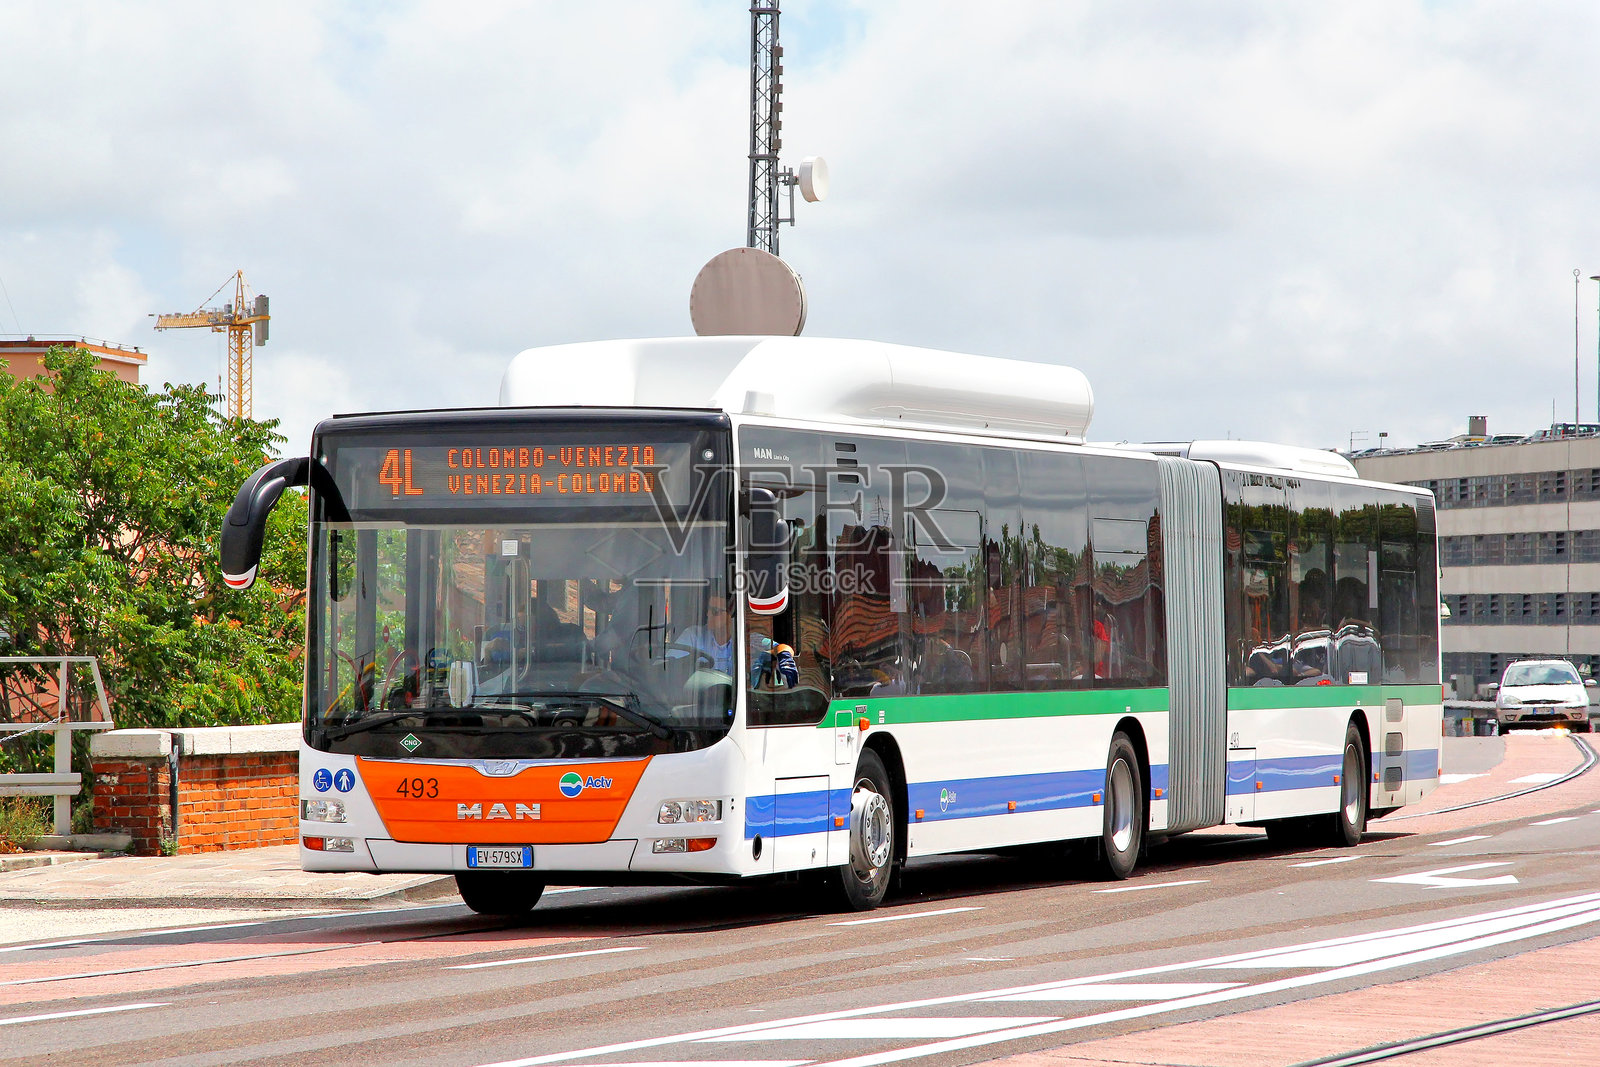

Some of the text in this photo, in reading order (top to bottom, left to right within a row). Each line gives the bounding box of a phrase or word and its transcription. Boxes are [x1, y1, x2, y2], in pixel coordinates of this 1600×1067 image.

[447, 446, 655, 469] COLOMBO-VENEZIA
[753, 447, 773, 460] MAN
[379, 449, 423, 495] 4L
[447, 472, 655, 495] VENEZIA-COLOMBO
[396, 777, 439, 799] 493
[584, 775, 613, 789] Actv
[457, 803, 541, 820] MAN
